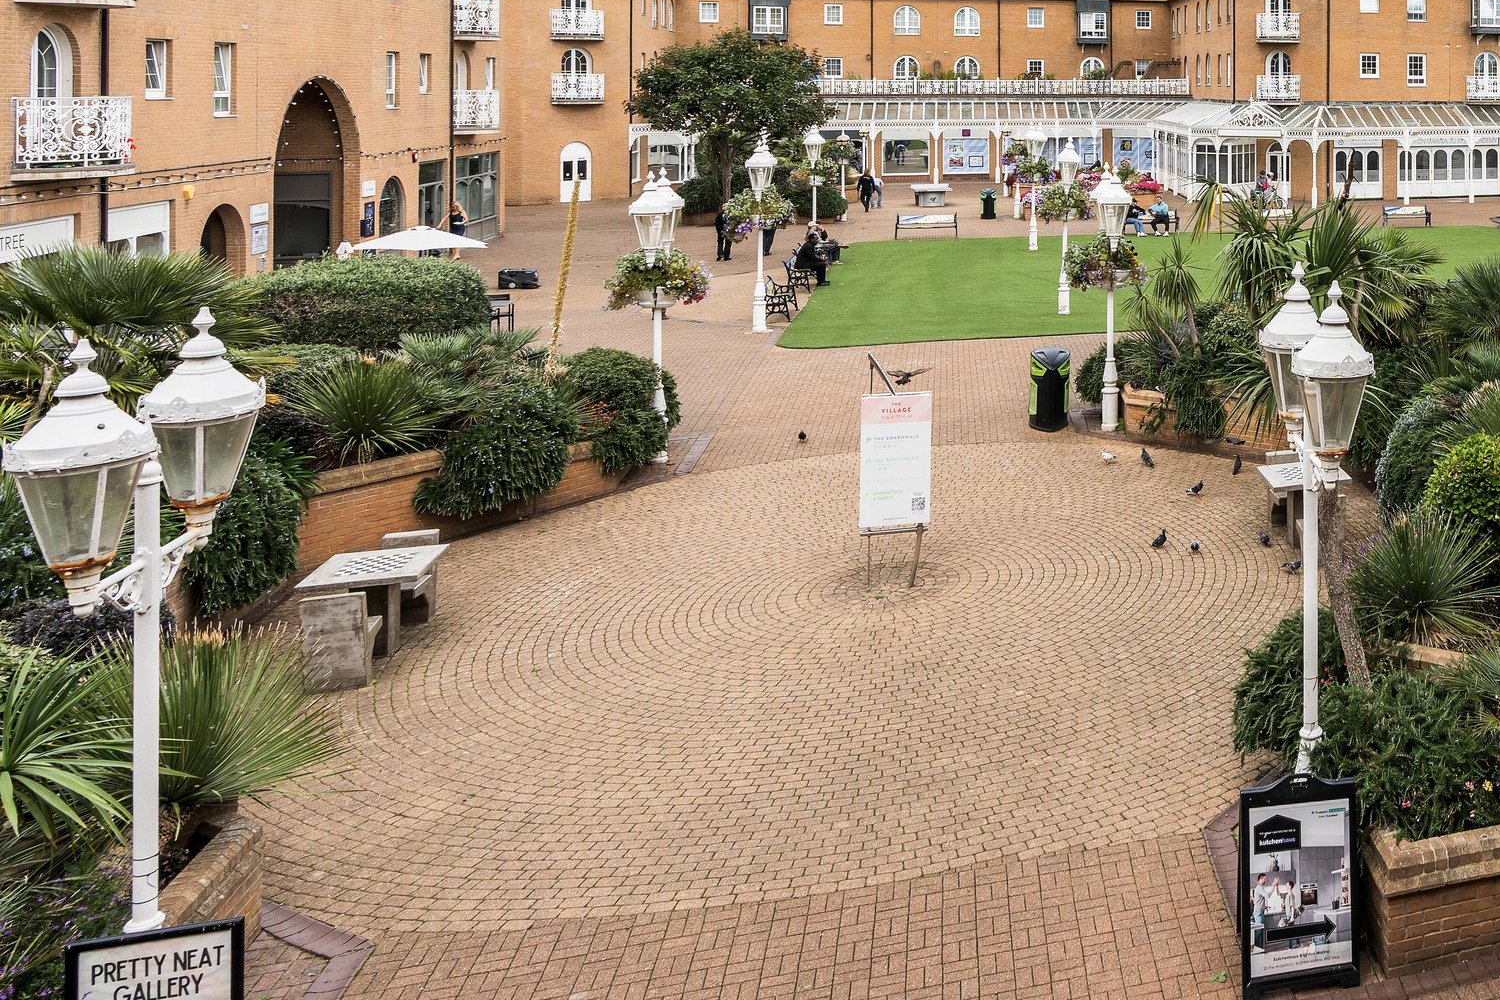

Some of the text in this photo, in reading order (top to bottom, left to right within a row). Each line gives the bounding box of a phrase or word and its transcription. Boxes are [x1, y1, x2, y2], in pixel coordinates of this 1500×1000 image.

[91, 945, 225, 986] PRETTY NEAT
[113, 973, 204, 1000] GALLERY
